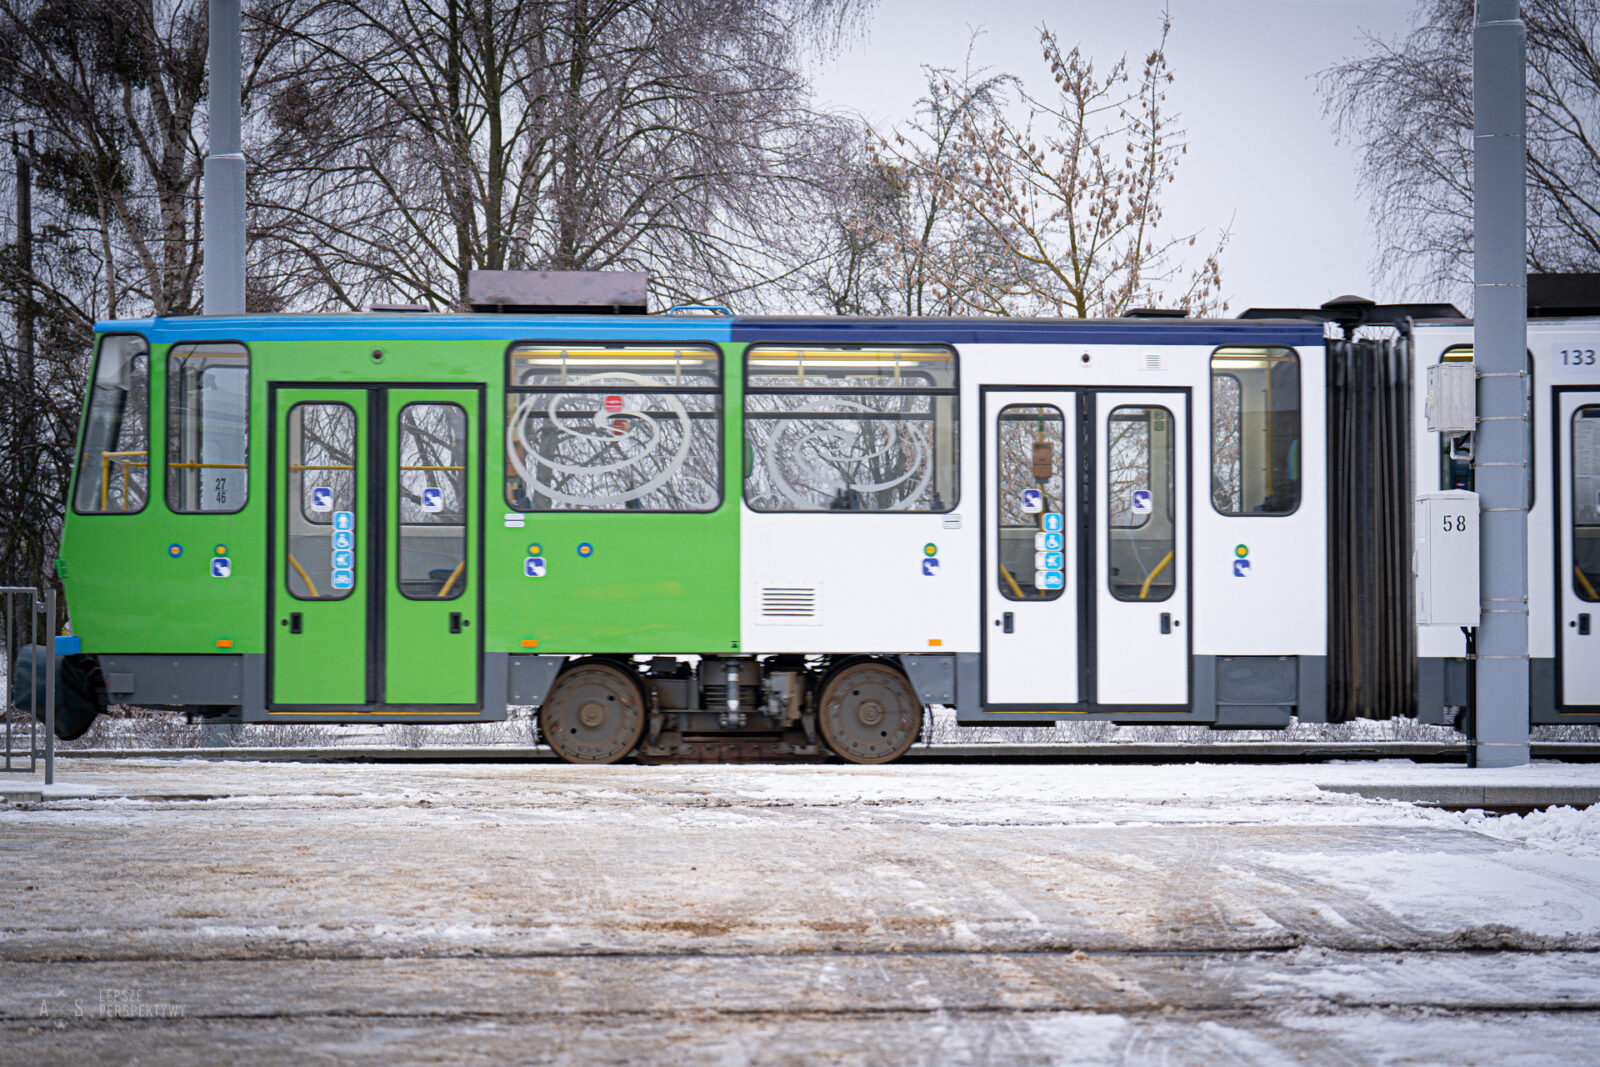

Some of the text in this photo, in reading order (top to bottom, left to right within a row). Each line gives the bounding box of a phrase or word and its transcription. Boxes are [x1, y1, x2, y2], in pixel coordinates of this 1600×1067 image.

[1560, 349, 1596, 366] 133
[215, 478, 226, 490] 27
[215, 491, 227, 504] 46
[1443, 514, 1466, 532] 58
